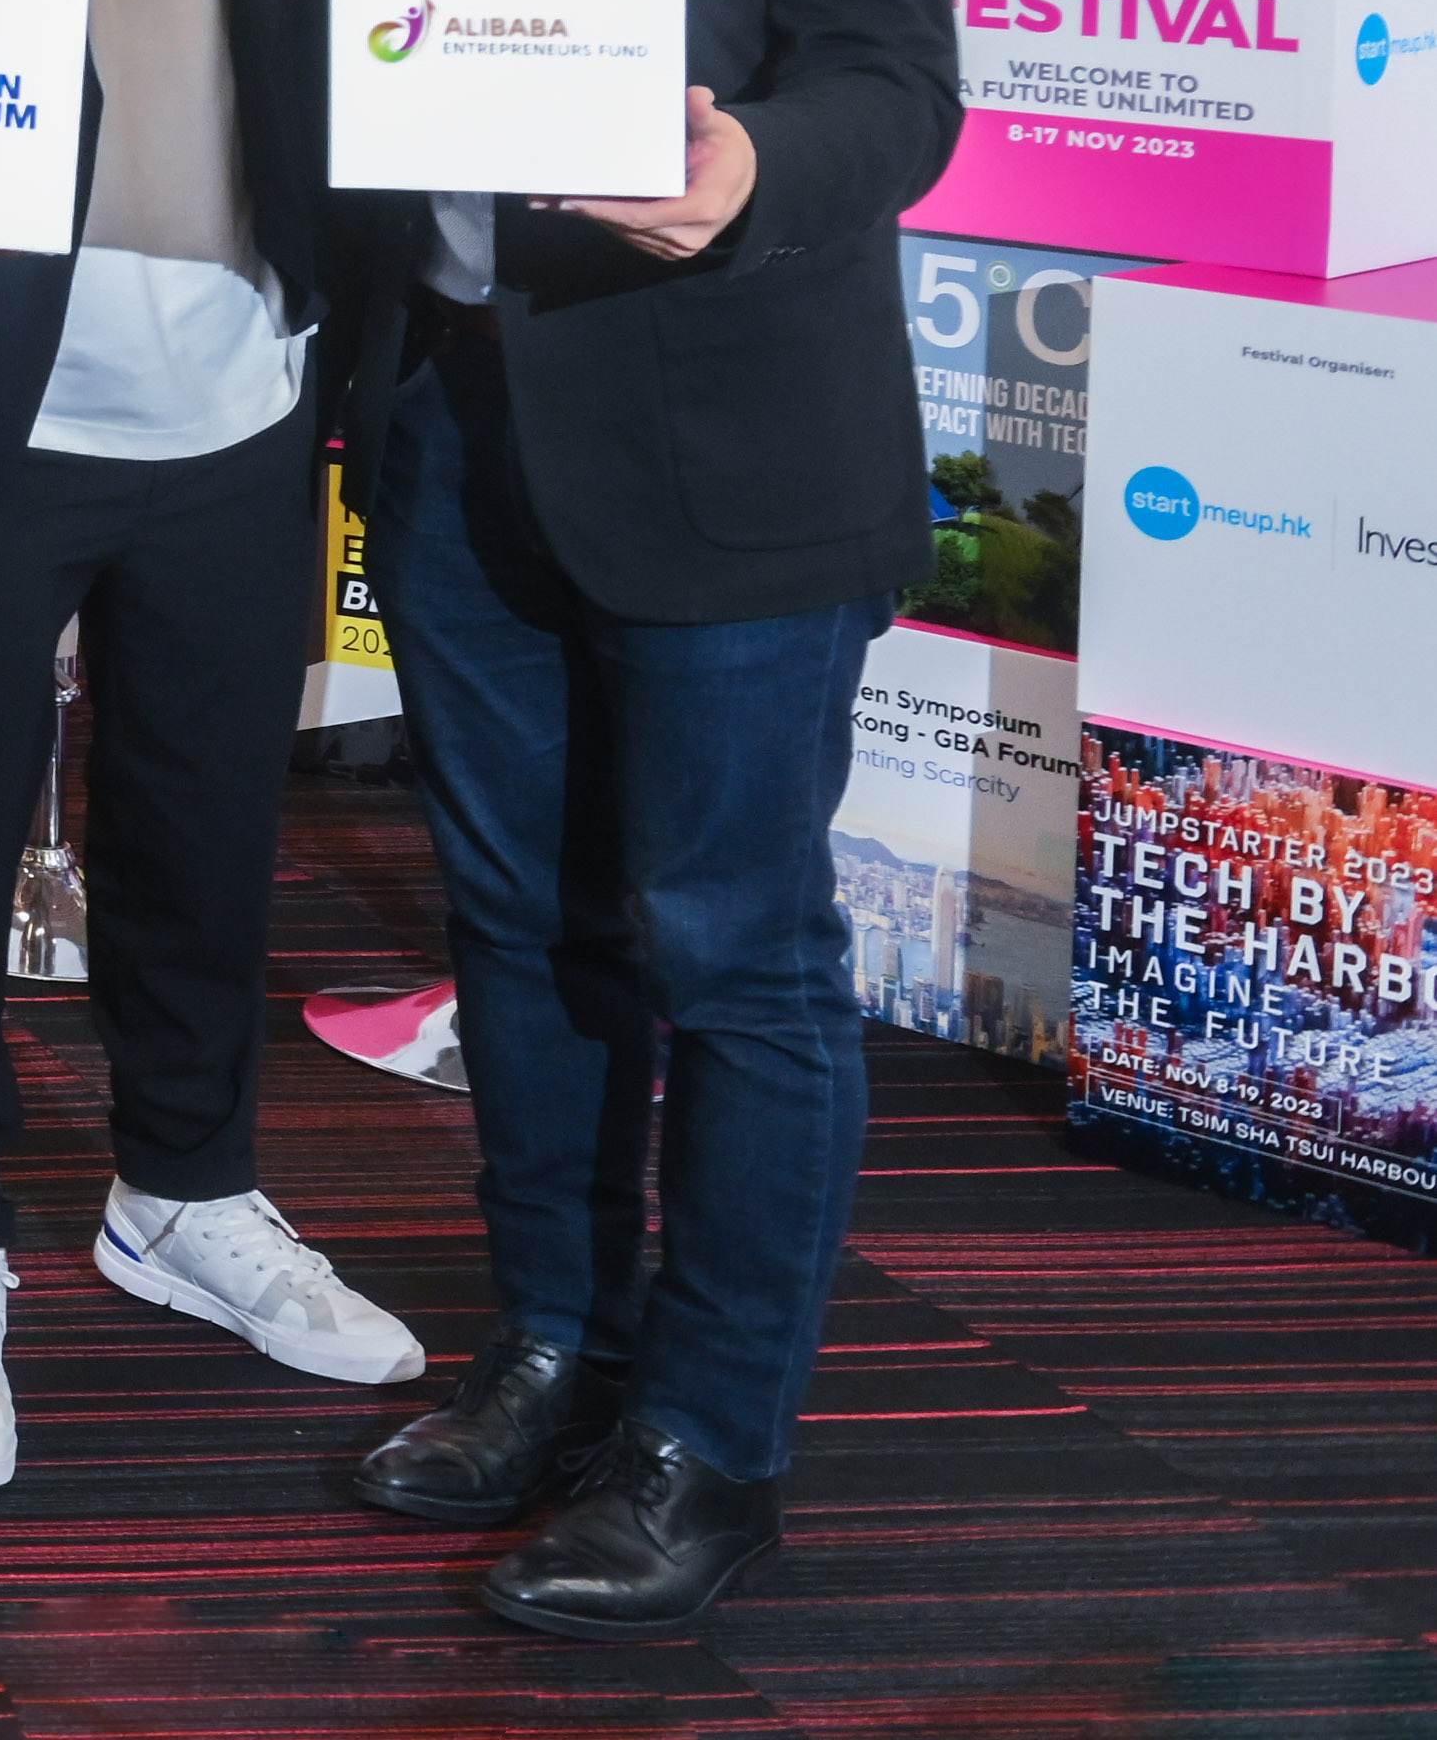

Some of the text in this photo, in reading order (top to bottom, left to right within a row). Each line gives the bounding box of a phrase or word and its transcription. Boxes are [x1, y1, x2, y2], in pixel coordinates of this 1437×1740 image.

[443, 42, 648, 57] ENTREPRENEURS FUND
[444, 17, 568, 37] ALIBABA
[983, 80, 1087, 107] FUTURE
[1098, 92, 1254, 121] UNLIMITED
[1010, 60, 1198, 94] WELCOME TO
[1008, 124, 1195, 159] 8-17 NOV 2023
[1242, 345, 1394, 379] Festival Organiser:
[986, 412, 1042, 448] WITH
[1132, 489, 1311, 539] start meup.hk
[897, 690, 1041, 738] Symposium
[934, 729, 989, 758] GBA
[999, 742, 1080, 777] Forum
[924, 761, 1019, 802] Scarcity
[1095, 799, 1434, 895] JUMPSTARTER 2023
[1093, 833, 1365, 934] TECH BY
[1091, 885, 1207, 954] THE
[1089, 939, 1284, 1015] IMAGINE
[1088, 982, 1395, 1085] THE FUTURE
[1102, 1047, 1323, 1120] DATE: NOV 8-19, 2023
[1101, 1086, 1174, 1118] VENUE:
[1179, 1106, 1230, 1134] TSIM
[1236, 1122, 1279, 1148] SHA
[1286, 1136, 1334, 1163] TSUI
